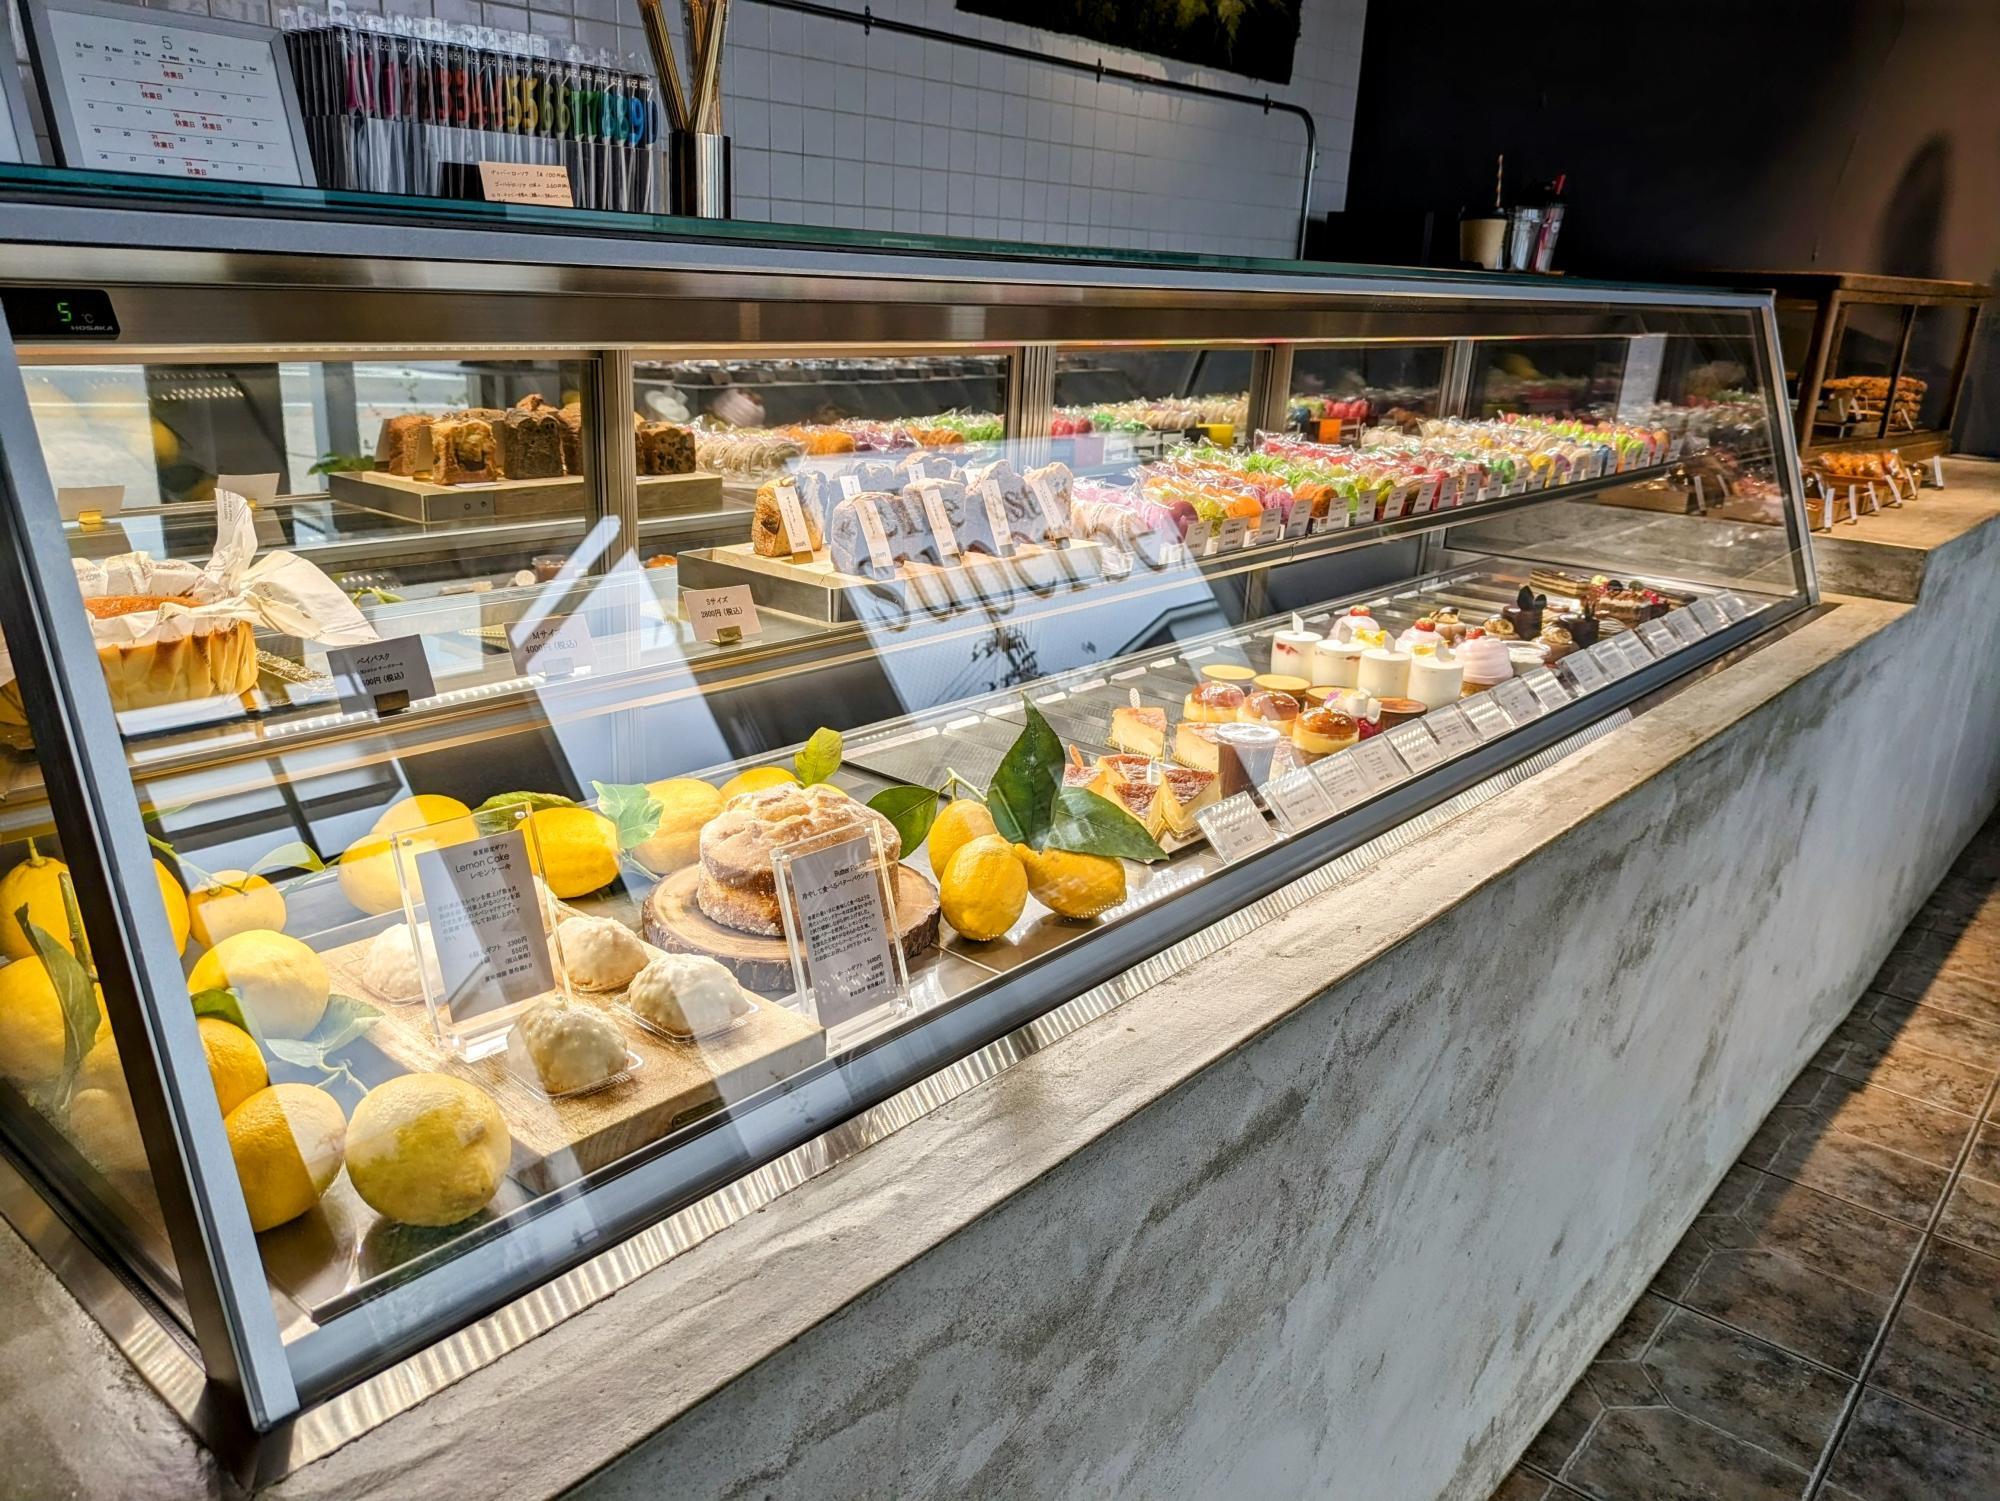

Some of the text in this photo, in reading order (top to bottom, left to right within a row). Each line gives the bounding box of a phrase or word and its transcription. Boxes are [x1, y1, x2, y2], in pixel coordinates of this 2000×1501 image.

[161, 35, 173, 50] 5
[163, 70, 184, 80] 休業日
[141, 91, 162, 100] 休業日
[175, 119, 222, 131] 休業日 休業日
[153, 140, 174, 149] 休業日
[187, 168, 207, 176] 休業日
[57, 302, 72, 322] 5
[705, 595, 729, 606] Sサイズ
[455, 853, 510, 873] Lemon Cake
[470, 863, 512, 879] レモンケーキ
